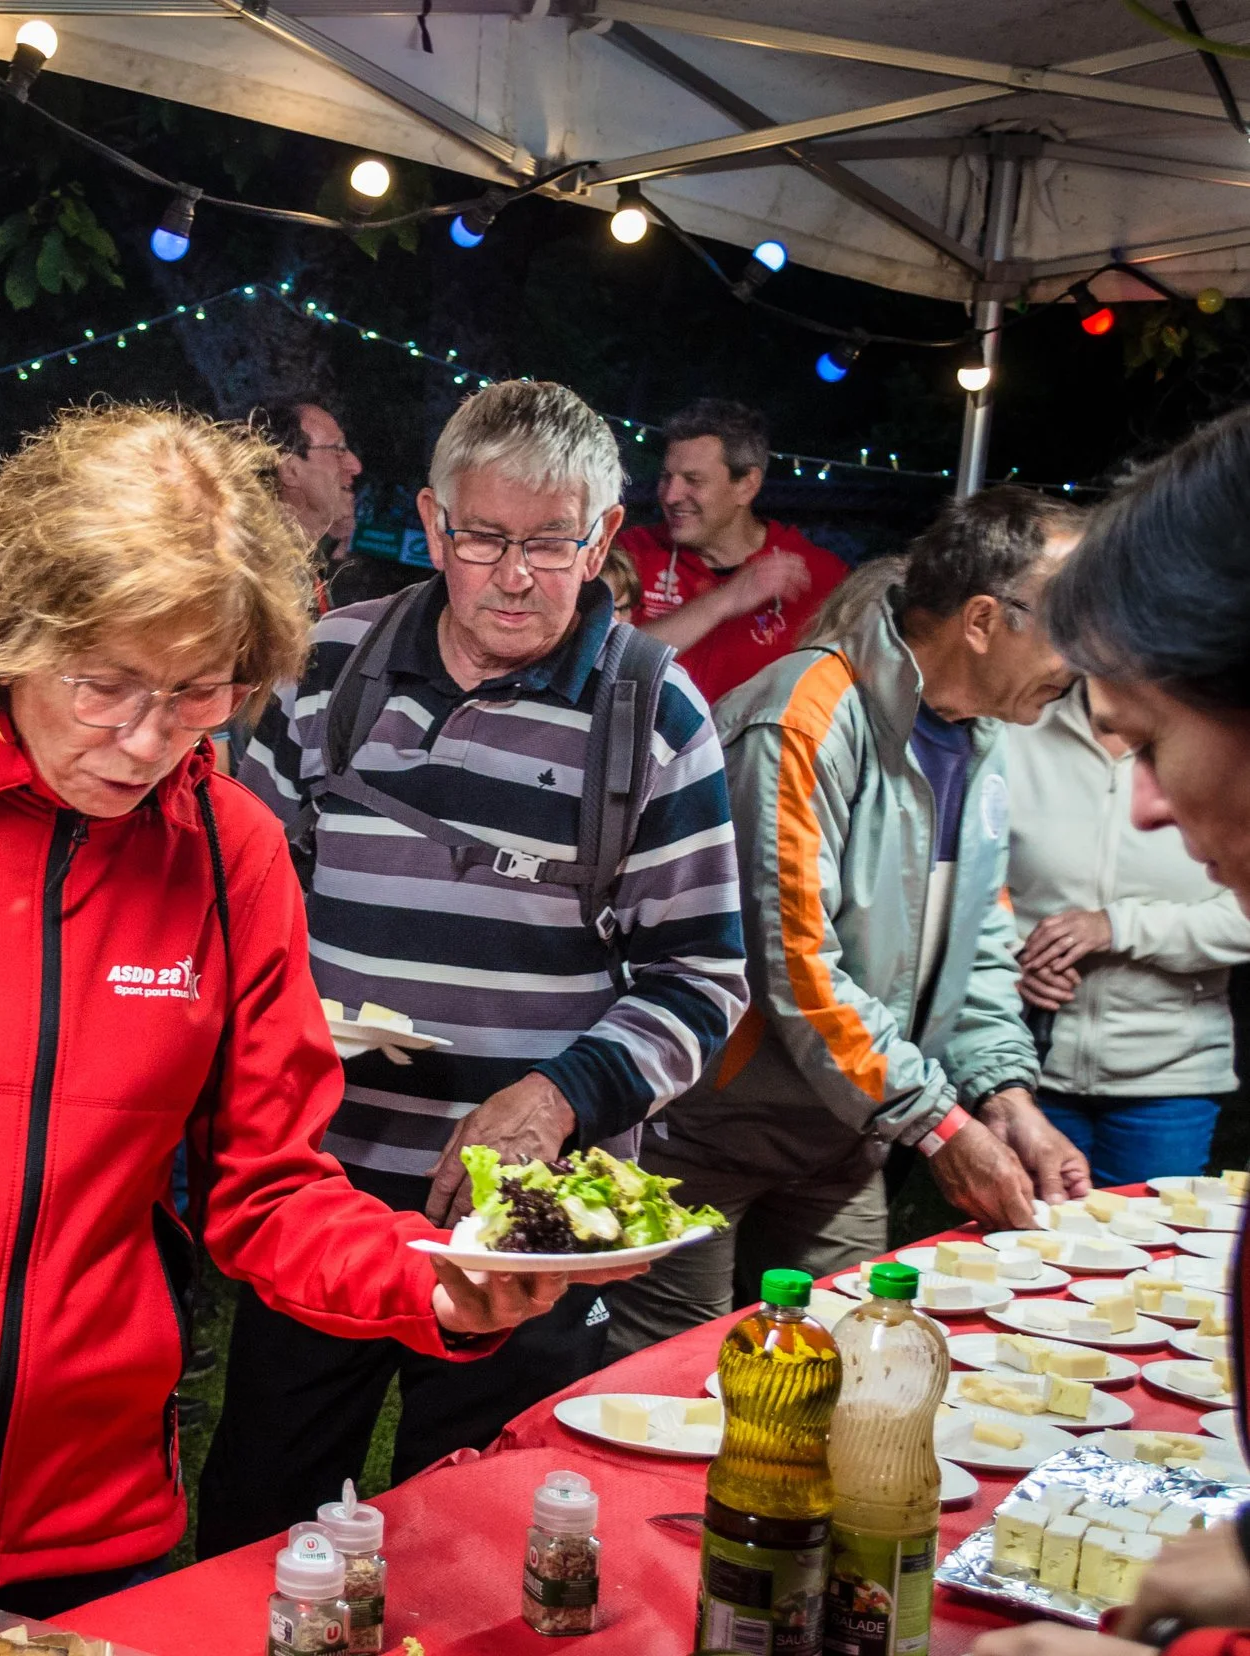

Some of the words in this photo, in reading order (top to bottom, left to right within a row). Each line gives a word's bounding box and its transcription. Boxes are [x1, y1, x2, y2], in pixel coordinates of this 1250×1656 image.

[107, 965, 155, 984] ASDD
[157, 968, 181, 985] 28
[114, 984, 143, 997] Sport
[144, 987, 169, 998] pour
[831, 1612, 886, 1634] SALADE
